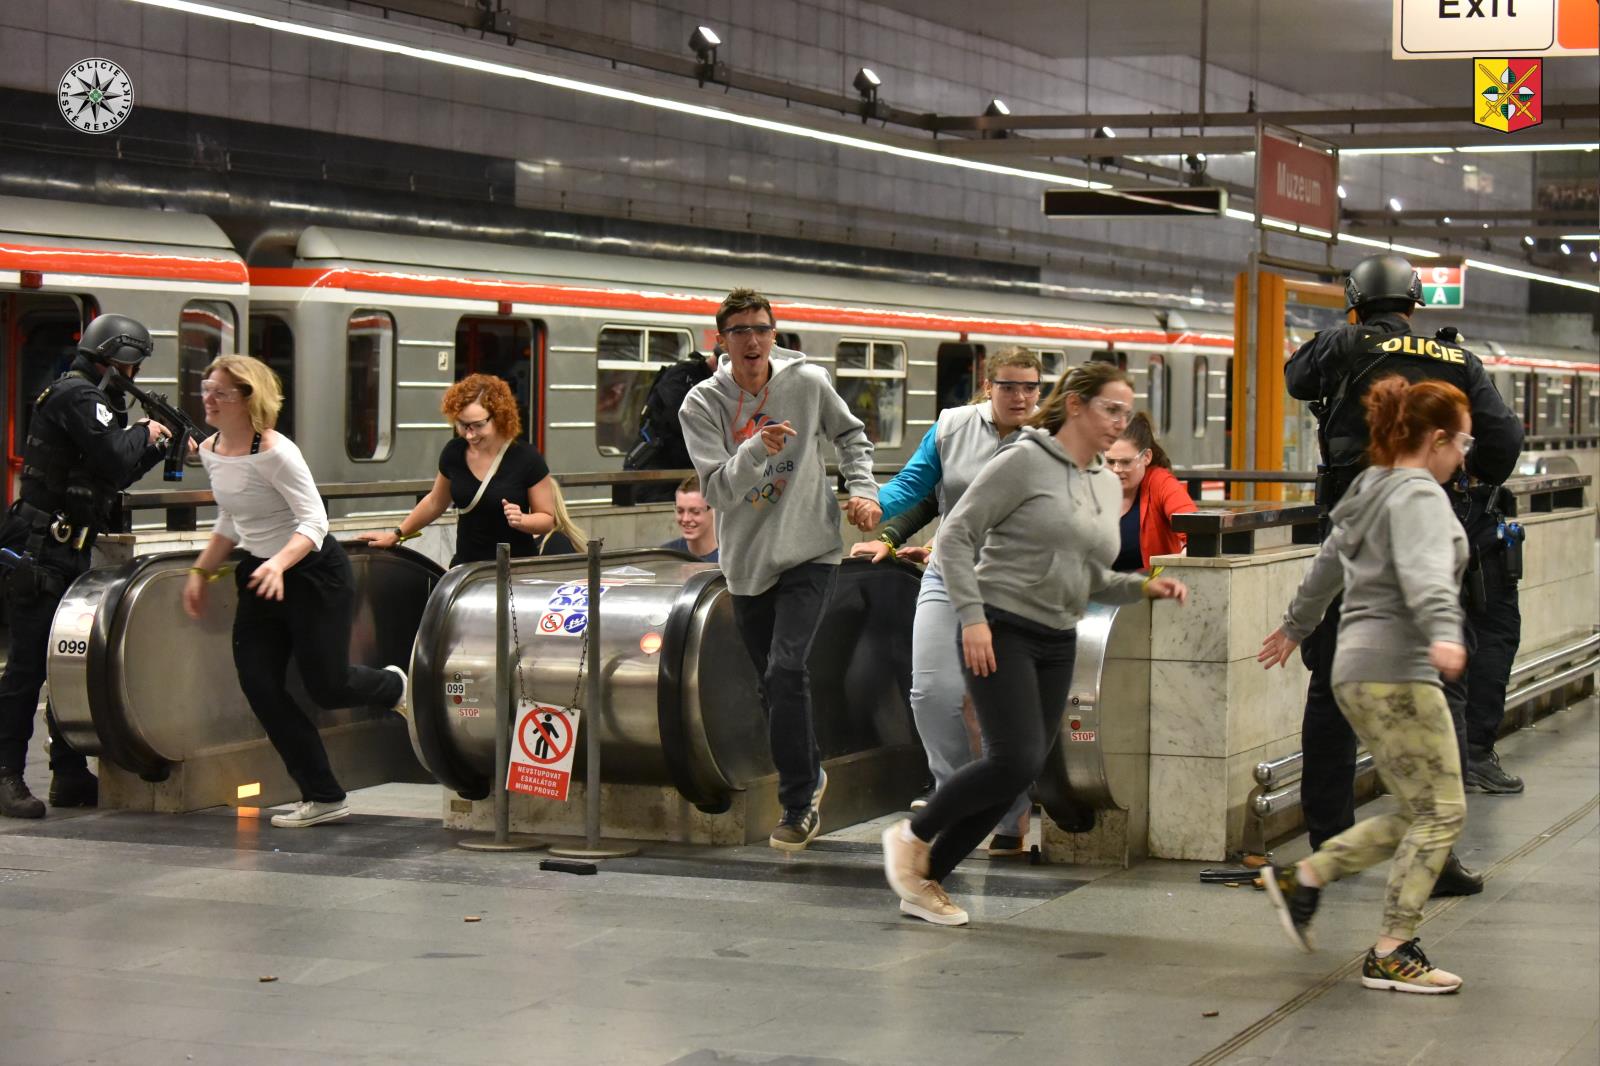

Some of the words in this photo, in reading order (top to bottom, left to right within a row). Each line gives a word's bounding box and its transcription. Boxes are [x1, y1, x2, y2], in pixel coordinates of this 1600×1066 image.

[1276, 161, 1322, 206] Muzeum
[1431, 267, 1449, 285] C
[1431, 286, 1448, 305] A
[1375, 335, 1465, 364] OLICIE
[58, 640, 87, 654] 099
[447, 684, 464, 694] 099
[459, 708, 479, 717] STOP
[1071, 732, 1094, 741] STOP
[517, 765, 562, 780] NEVSTUPOVAT
[515, 782, 533, 792] MIMO
[533, 785, 560, 797] PROVOZ
